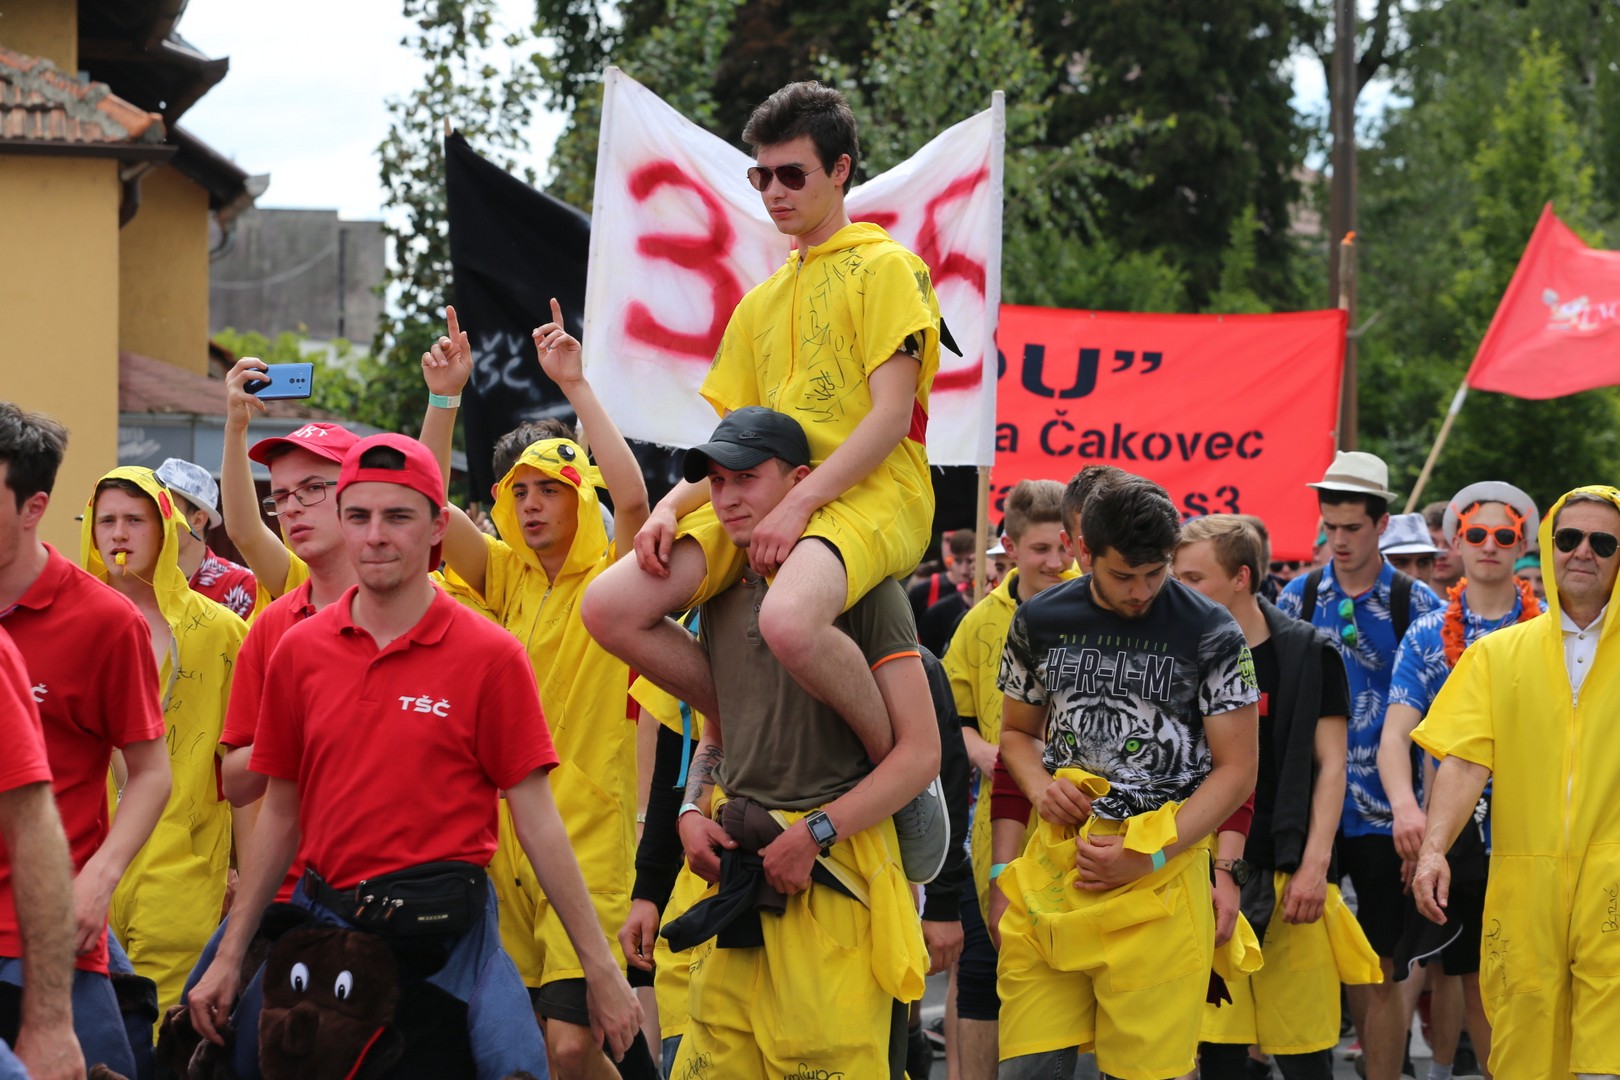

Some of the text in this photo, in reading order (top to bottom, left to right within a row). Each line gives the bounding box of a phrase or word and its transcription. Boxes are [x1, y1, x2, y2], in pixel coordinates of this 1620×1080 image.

[995, 408, 1265, 461] a Čakovec
[398, 694, 452, 718] TŠČ
